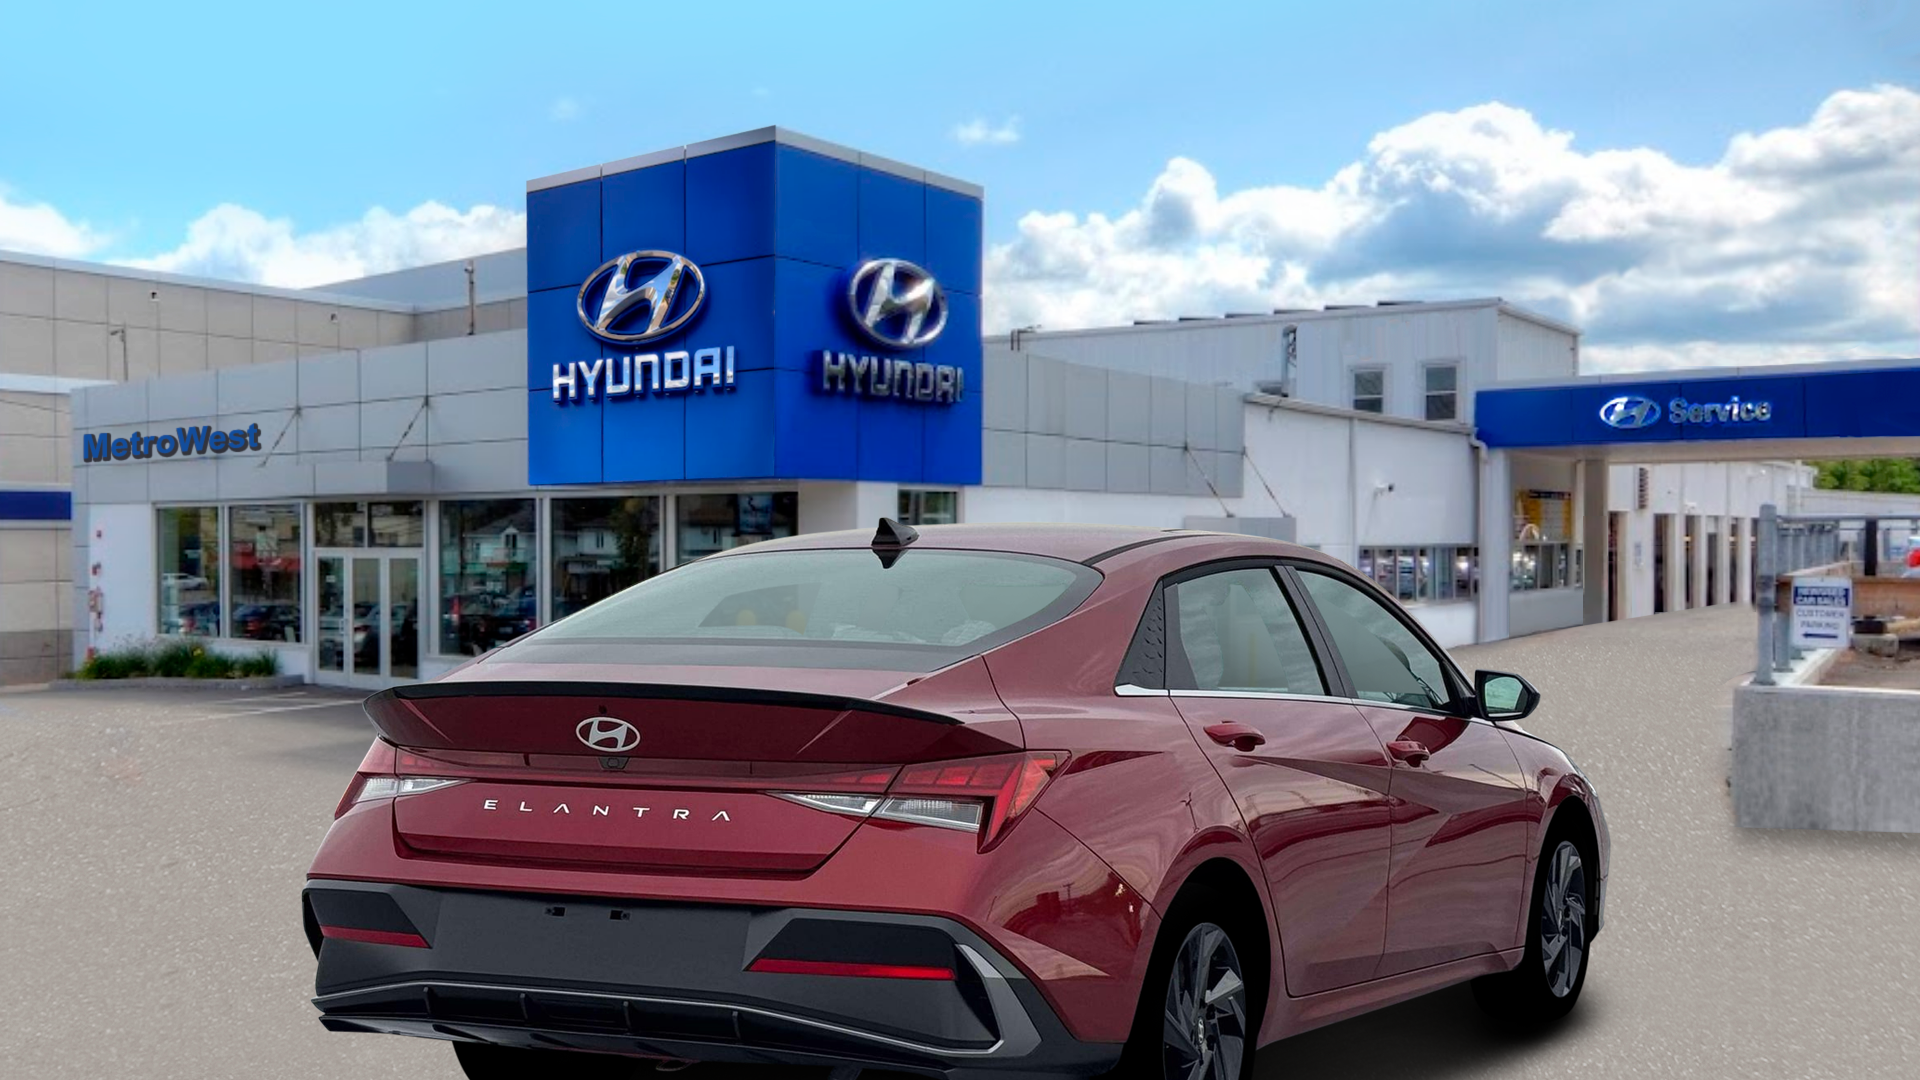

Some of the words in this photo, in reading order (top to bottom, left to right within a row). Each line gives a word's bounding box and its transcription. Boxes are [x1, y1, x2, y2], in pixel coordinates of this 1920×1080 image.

[552, 345, 735, 401] HYUNDAI
[821, 349, 965, 403] HYUNDAI
[1668, 396, 1772, 424] Service
[83, 423, 261, 463] MetroWest
[1796, 596, 1816, 605] CAR
[1796, 609, 1845, 618] CUSTOMER
[1801, 620, 1839, 630] PARKING
[483, 799, 731, 822] ELANTRA
